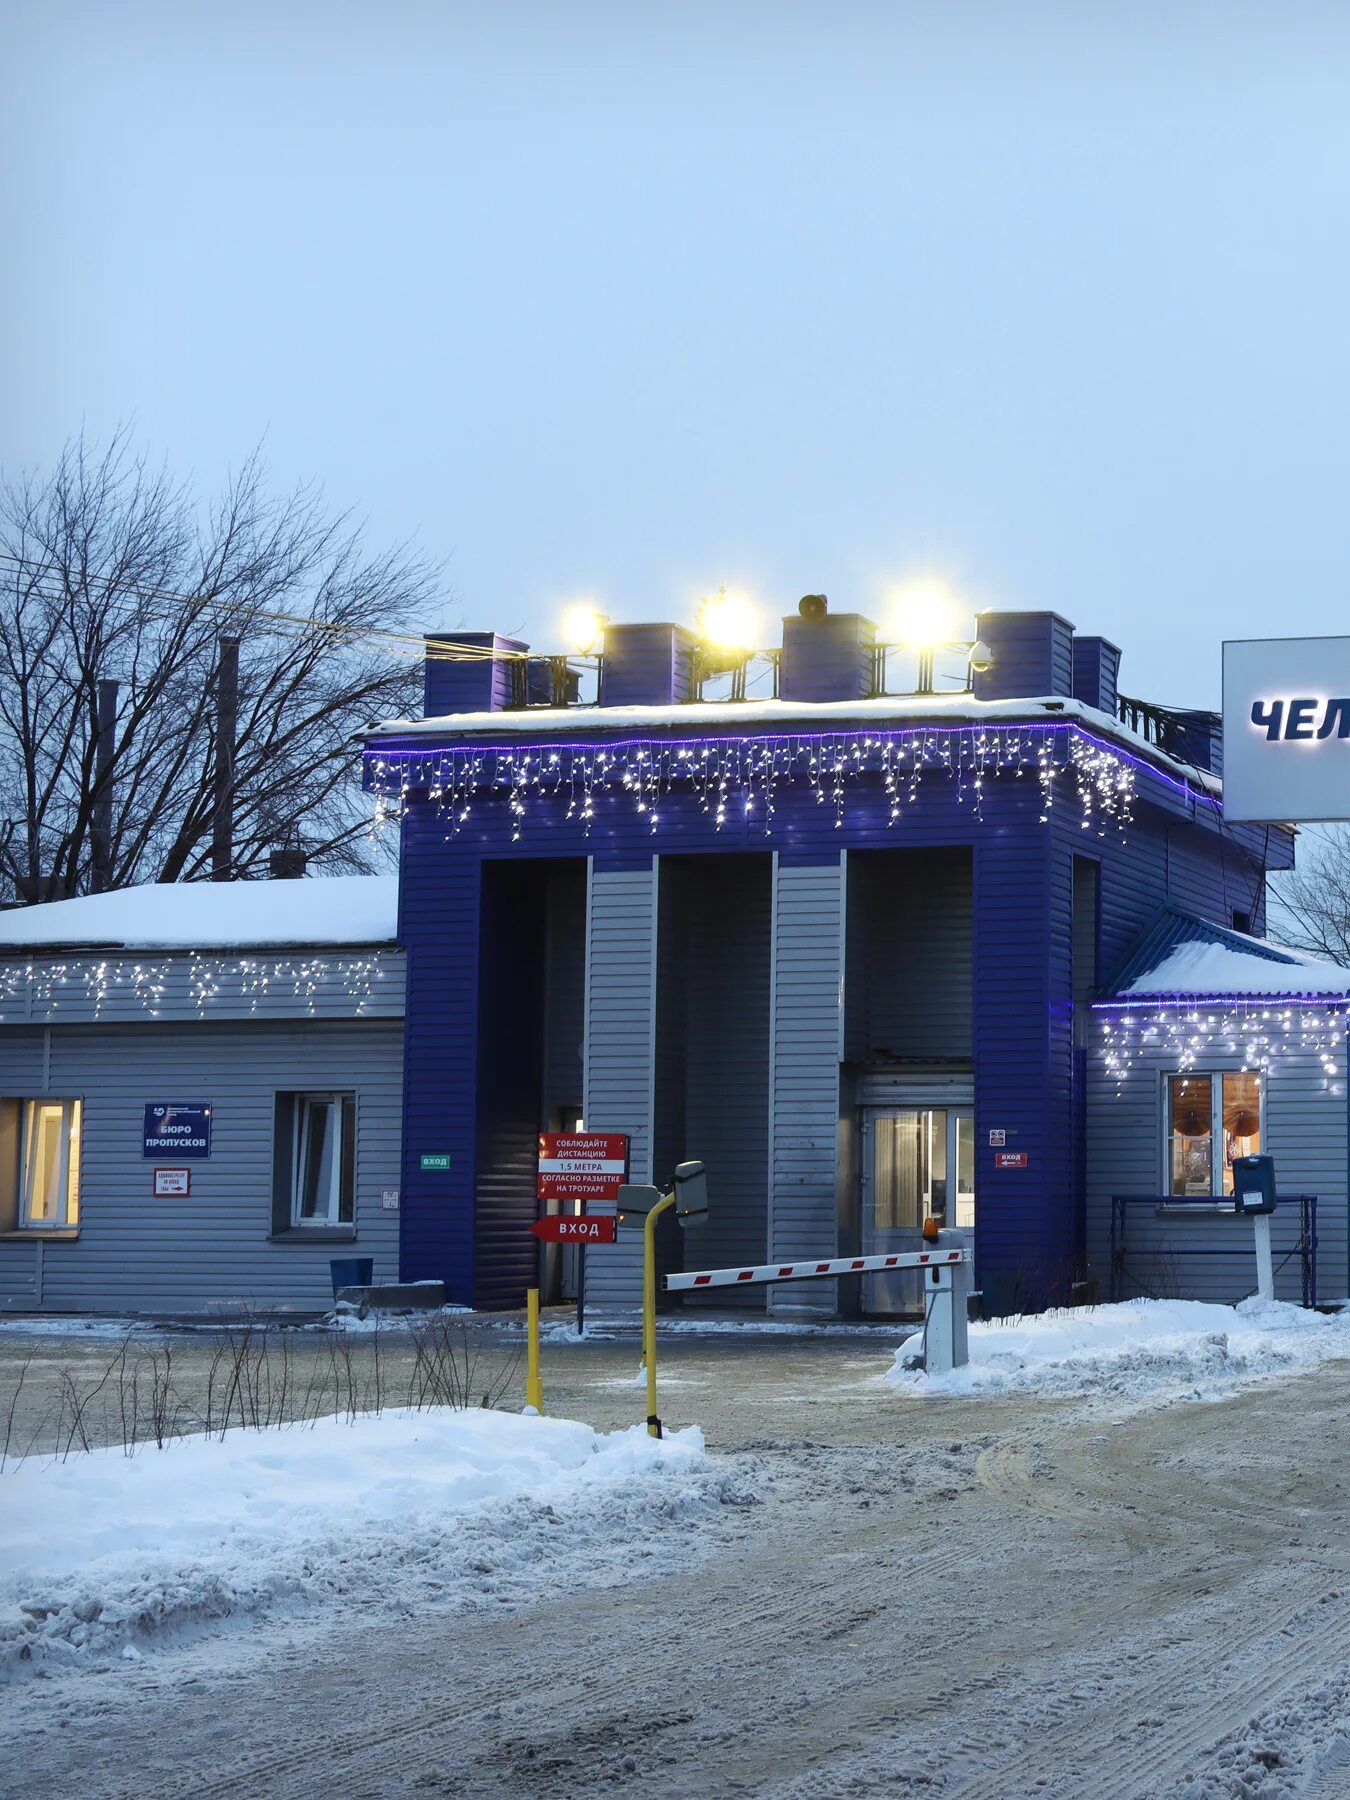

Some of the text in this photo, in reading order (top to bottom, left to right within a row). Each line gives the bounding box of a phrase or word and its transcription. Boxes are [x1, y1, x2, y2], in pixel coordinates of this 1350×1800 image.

[160, 1125, 192, 1134] БЮРО
[145, 1138, 206, 1147] ПРОПУСКОВ
[556, 1139, 608, 1148] СОБЛЮДАЙТЕ
[556, 1150, 607, 1158] ДИСТАНЦИЮ
[423, 1158, 447, 1166] ВХОД
[560, 1163, 603, 1171] 1,5 МЕТРА
[541, 1174, 620, 1183] СОГЛАСНО РАЗМЕТКЕ
[569, 1185, 605, 1193] ТРОТУАРЕ
[559, 1223, 599, 1237] ВХОД
